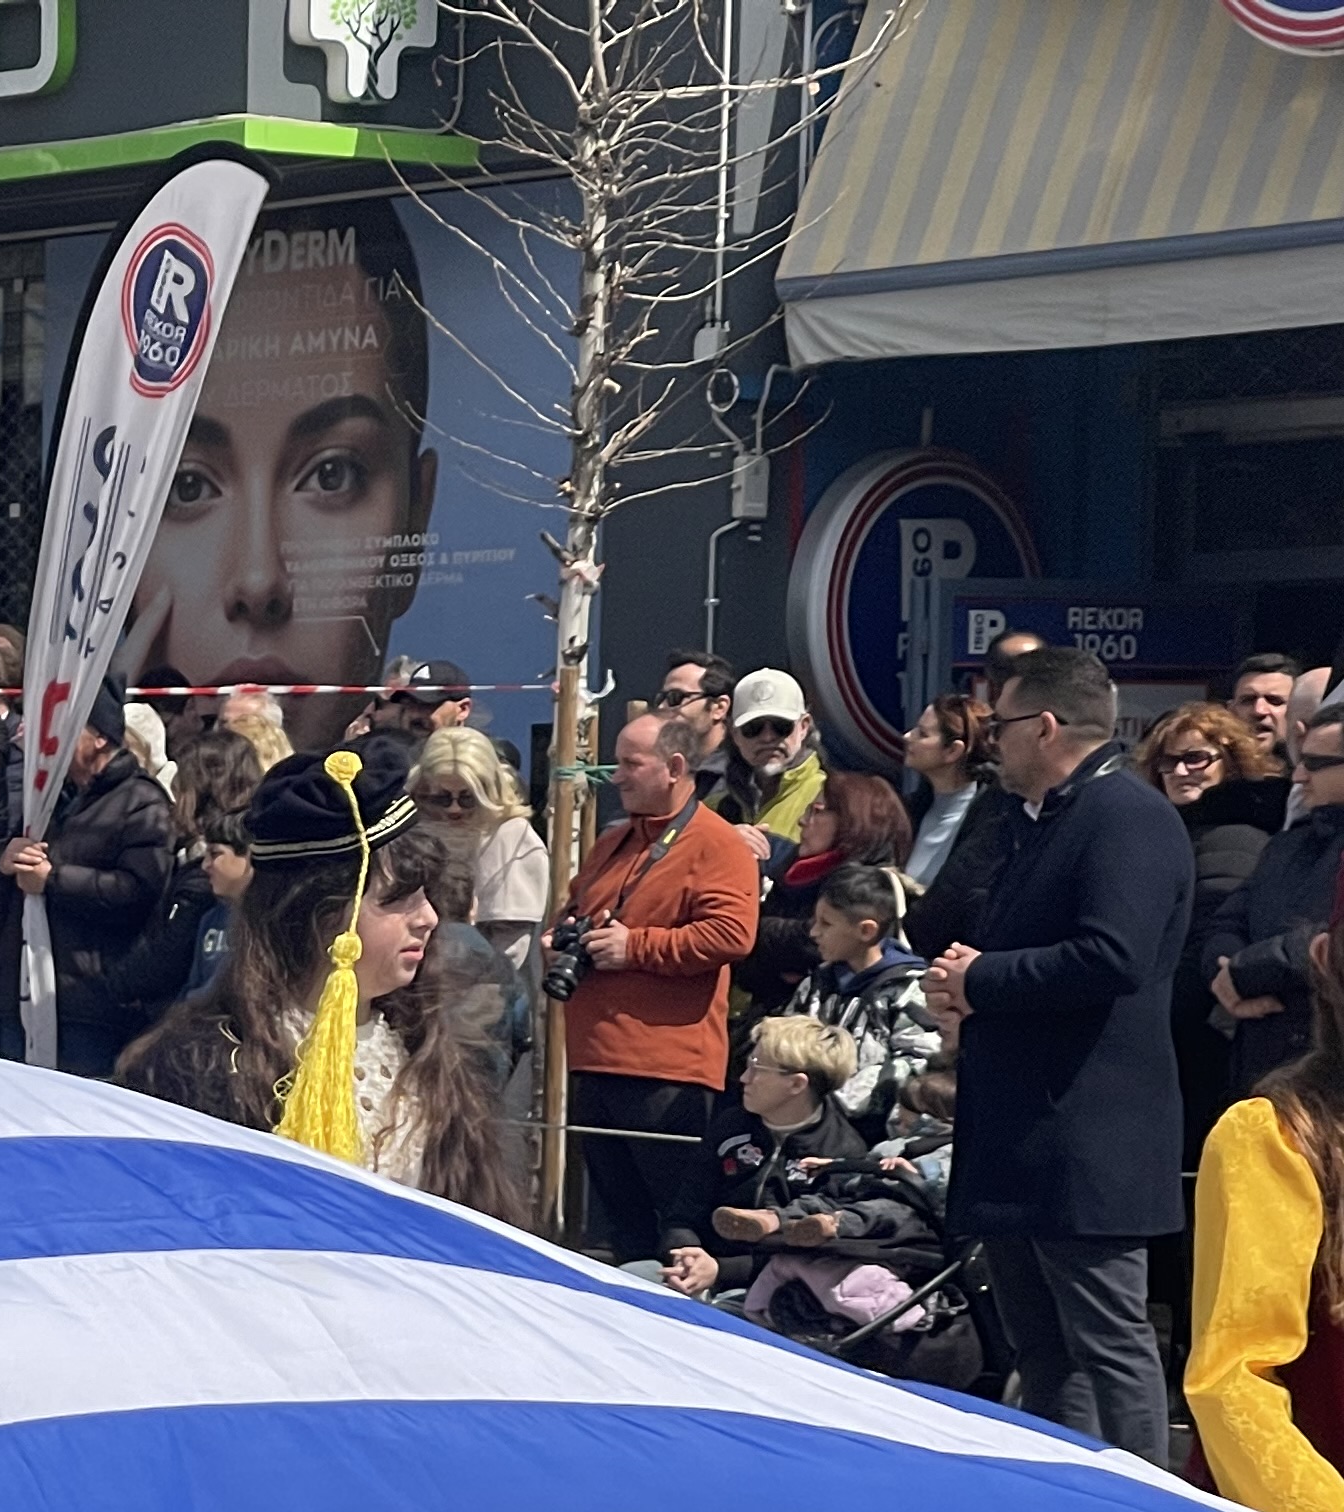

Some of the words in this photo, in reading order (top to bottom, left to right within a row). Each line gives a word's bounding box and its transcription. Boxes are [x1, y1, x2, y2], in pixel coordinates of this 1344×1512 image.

[247, 226, 356, 275] YDERM
[365, 276, 401, 303] ΓΙΑ
[289, 324, 379, 356] ΑΜΥΝΑ
[1073, 633, 1137, 660] 1960
